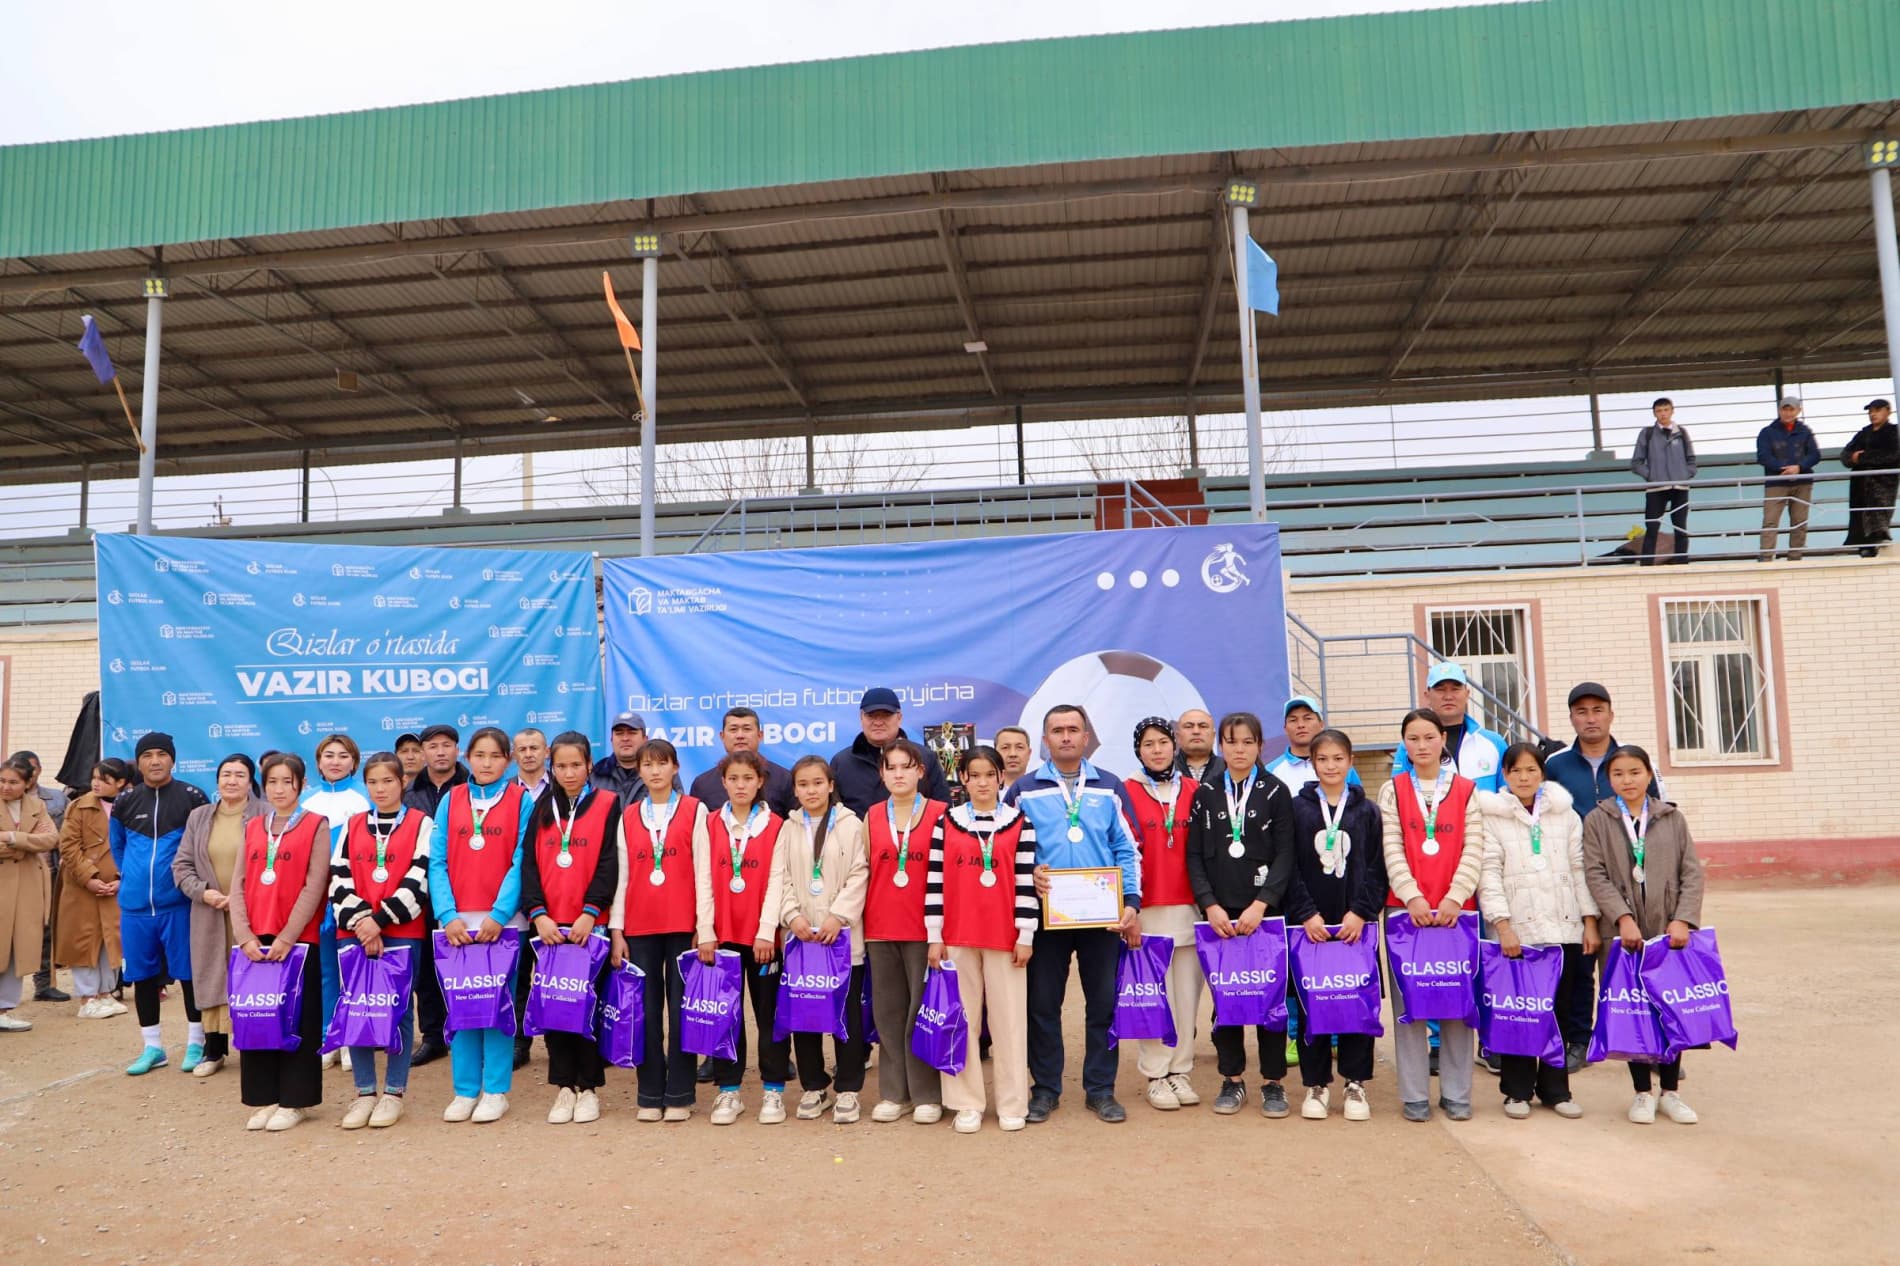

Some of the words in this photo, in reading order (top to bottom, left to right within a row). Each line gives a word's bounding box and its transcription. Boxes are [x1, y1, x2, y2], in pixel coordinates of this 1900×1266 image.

[671, 596, 706, 604] MAKTAB
[266, 628, 360, 657] Qizlar
[366, 628, 460, 656] o'rtasida
[236, 669, 352, 697] VAZIR
[362, 667, 489, 694] KUBOGI
[628, 694, 694, 712] Qizlar
[700, 689, 797, 710] o'rtasida
[803, 686, 868, 706] futbo
[889, 682, 975, 707] o'yicha
[646, 726, 715, 748] AZIR
[760, 721, 836, 745] BOGI
[968, 855, 999, 869] JAO
[1400, 960, 1472, 976] CLASSIC
[443, 974, 507, 990] CLASSIC
[533, 973, 590, 993] CLASSIC
[780, 972, 840, 989] CLASSIC
[1209, 969, 1277, 985] CLASSIC
[1301, 973, 1371, 990] CLASSIC
[1118, 982, 1166, 996] ASSIC
[1599, 987, 1650, 1003] CLASS
[1662, 980, 1729, 1004] CLASSIC
[228, 992, 287, 1007] CLASSIC
[681, 996, 728, 1015] CLASSIC
[1482, 993, 1554, 1012] CLASSIC
[917, 1003, 947, 1026] ASSIC
